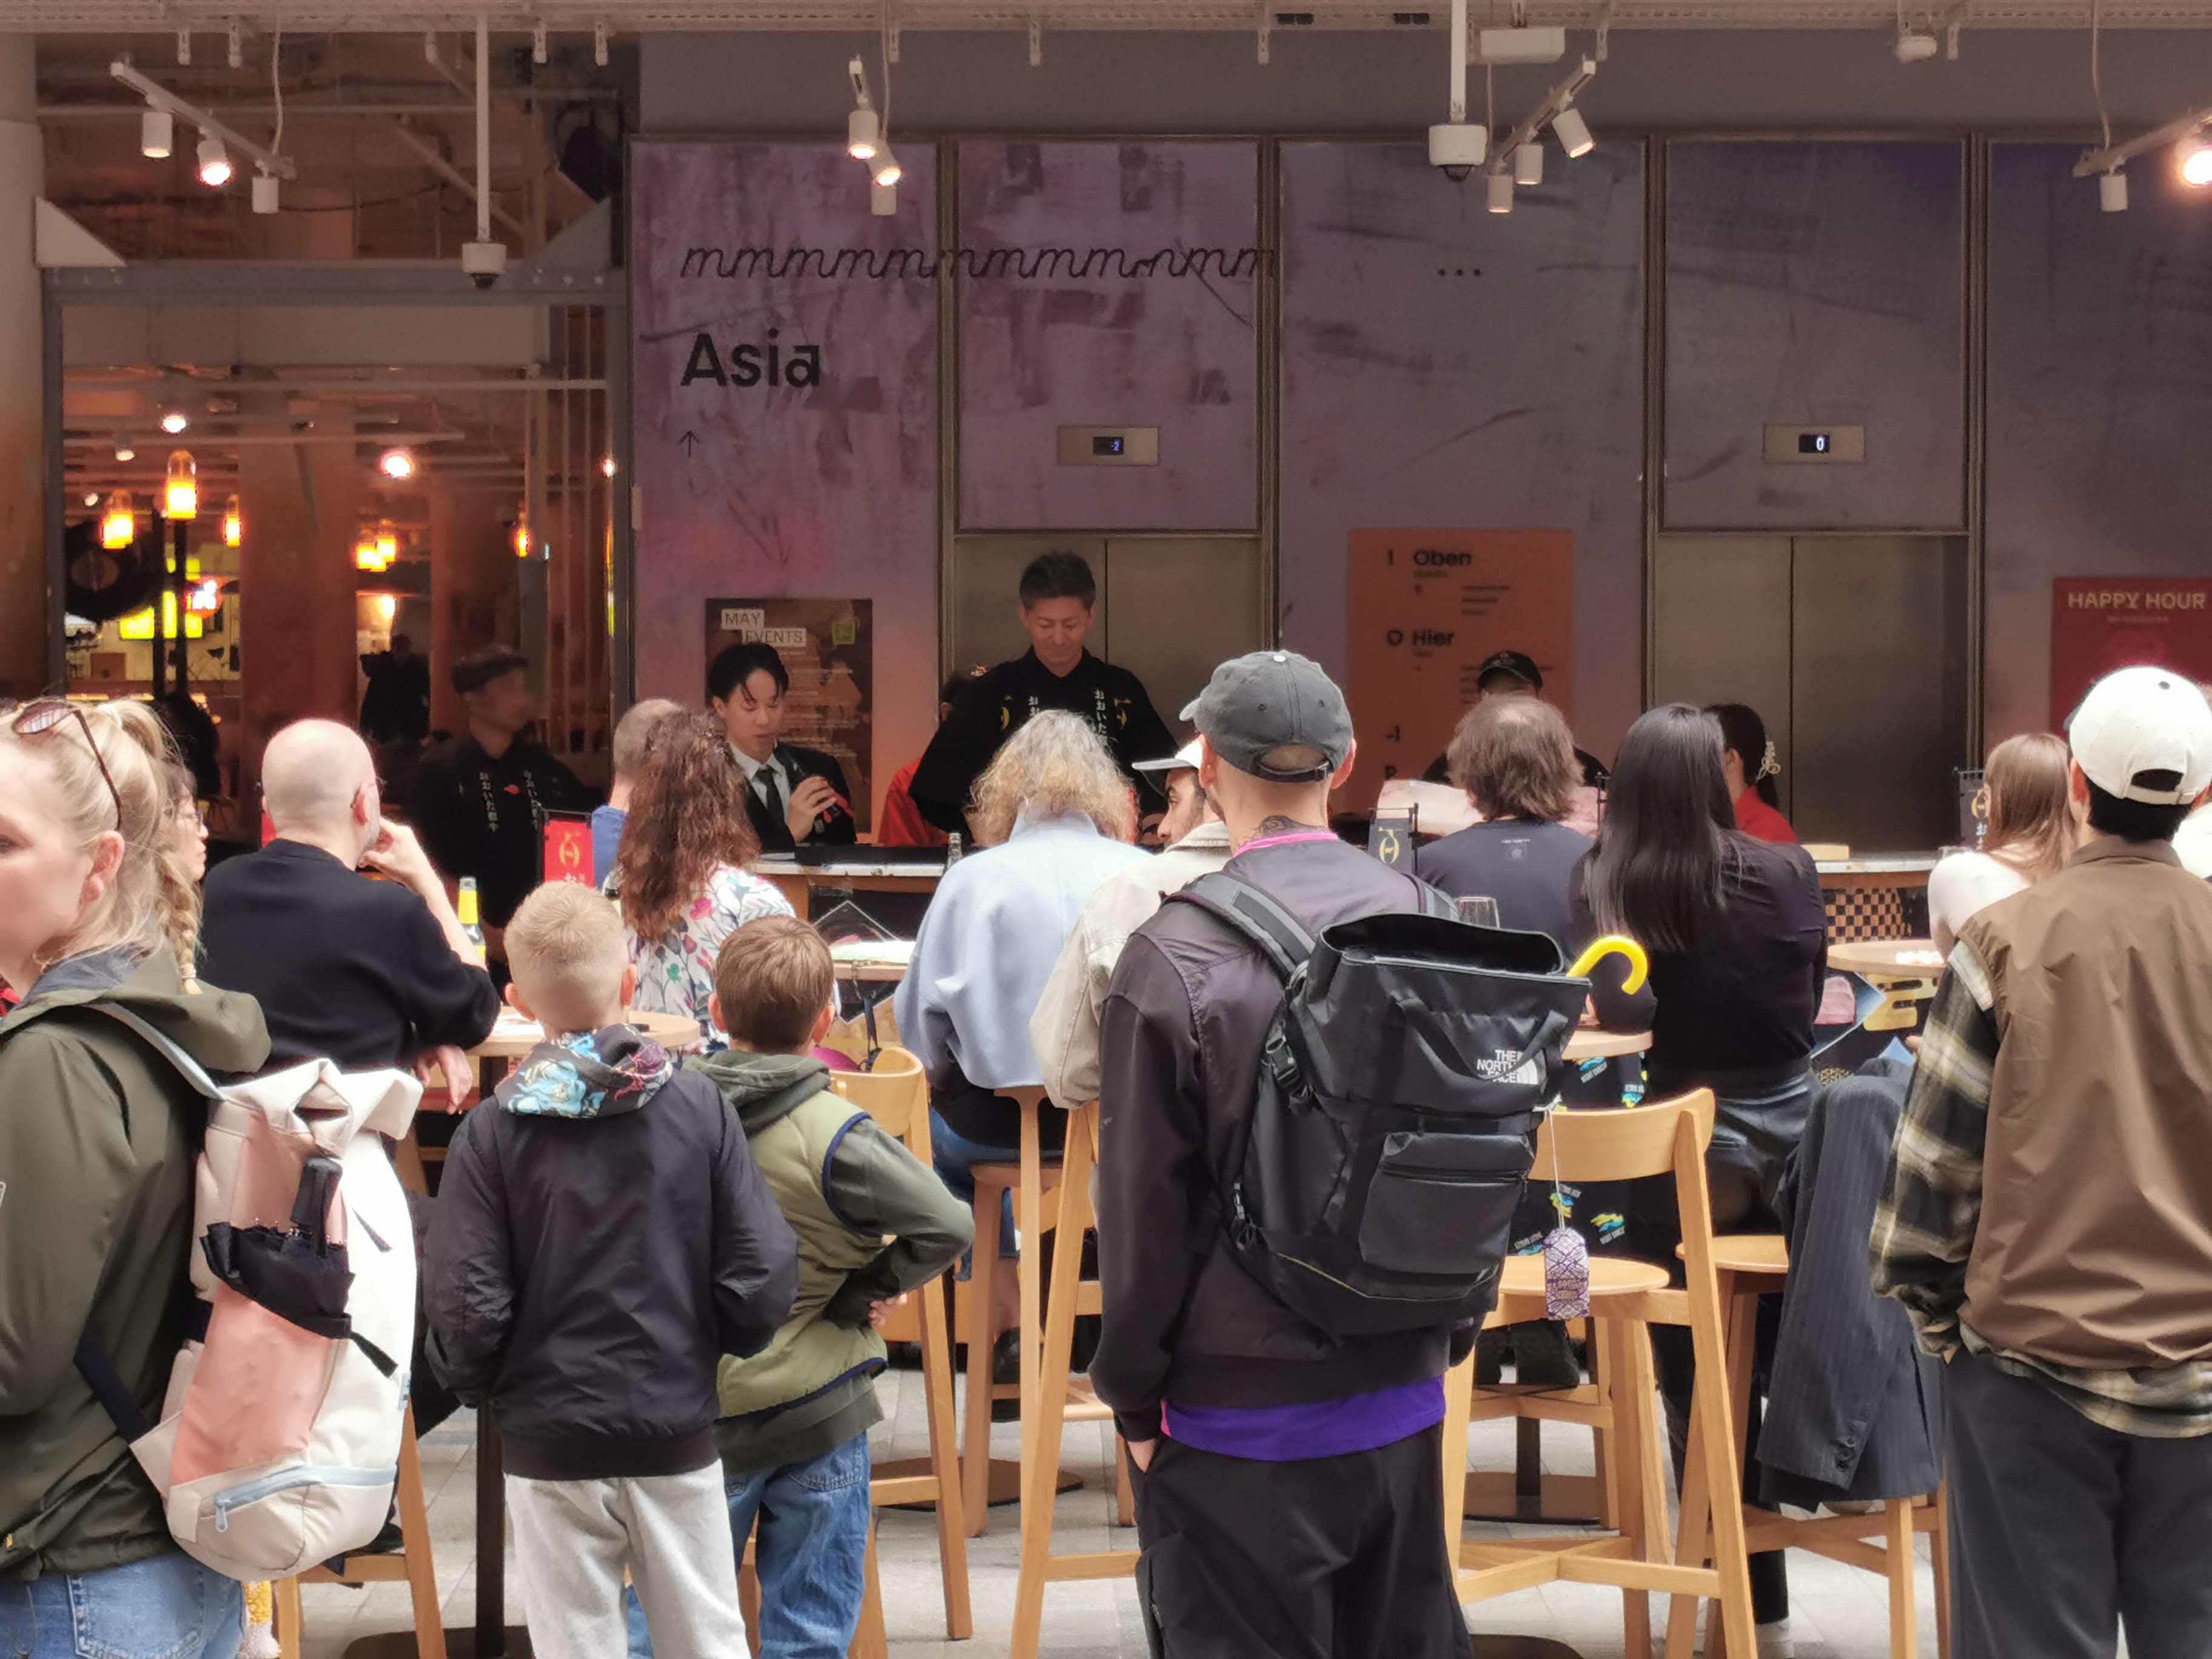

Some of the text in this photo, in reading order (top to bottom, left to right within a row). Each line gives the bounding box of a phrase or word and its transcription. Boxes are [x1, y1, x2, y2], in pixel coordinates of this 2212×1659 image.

[680, 328, 820, 388] Asia
[1816, 435, 1824, 451] 0
[1413, 548, 1473, 566] Oben
[2068, 591, 2207, 610] HAPPY HOUR
[725, 612, 761, 627] MAY
[745, 629, 803, 644] EVENTS
[1413, 628, 1455, 646] Hier
[1494, 1049, 1516, 1062] THE
[1476, 1058, 1516, 1073] NORTH
